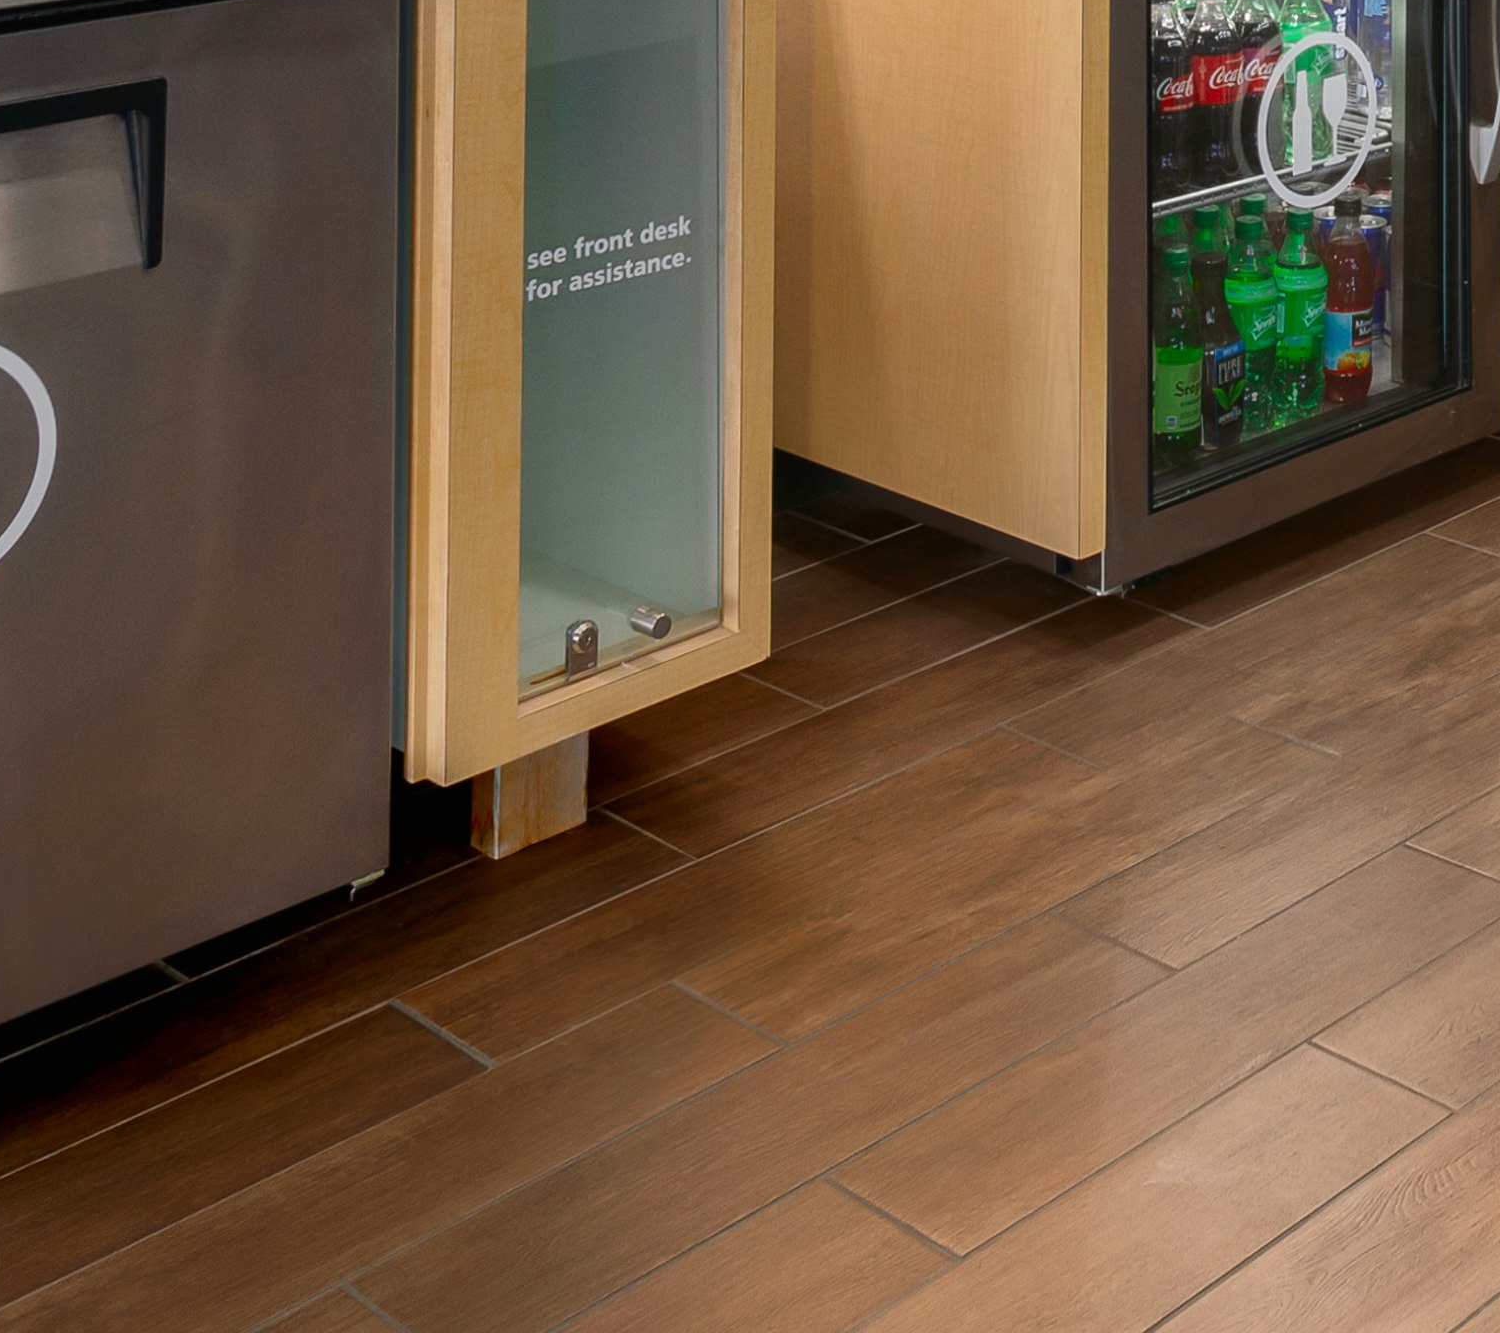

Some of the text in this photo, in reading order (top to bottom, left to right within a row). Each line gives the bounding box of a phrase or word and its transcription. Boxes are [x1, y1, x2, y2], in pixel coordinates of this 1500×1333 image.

[1335, 7, 1348, 59] sart
[526, 215, 692, 270] see front desk
[525, 251, 692, 303] for assistance.
